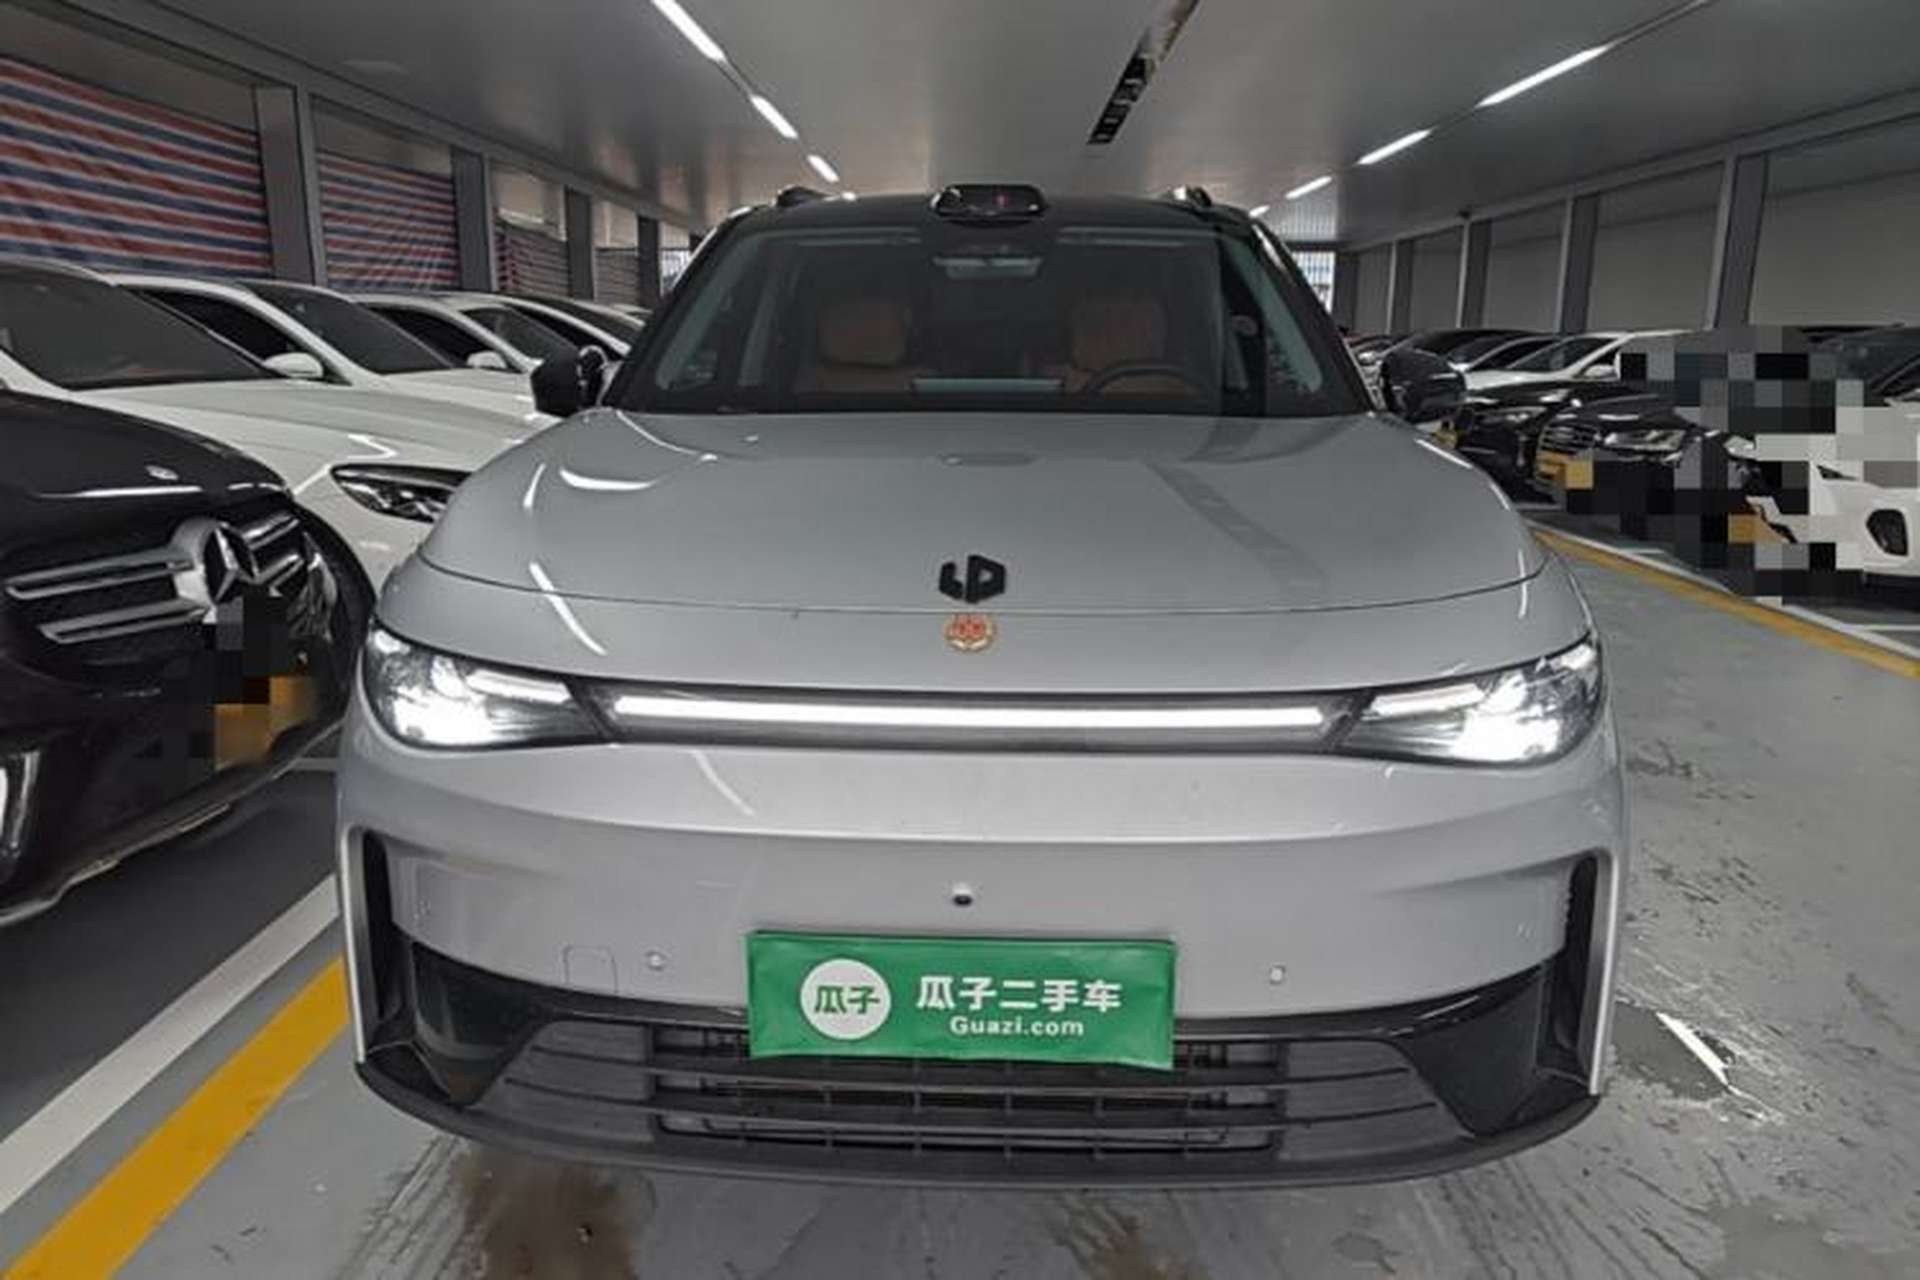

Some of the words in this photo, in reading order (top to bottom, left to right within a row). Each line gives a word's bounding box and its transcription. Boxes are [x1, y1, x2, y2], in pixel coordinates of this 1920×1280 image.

[814, 985, 881, 1015] 瓜子
[917, 975, 1122, 1012] 瓜子二手车
[949, 1014, 1085, 1037] Guazi.com
